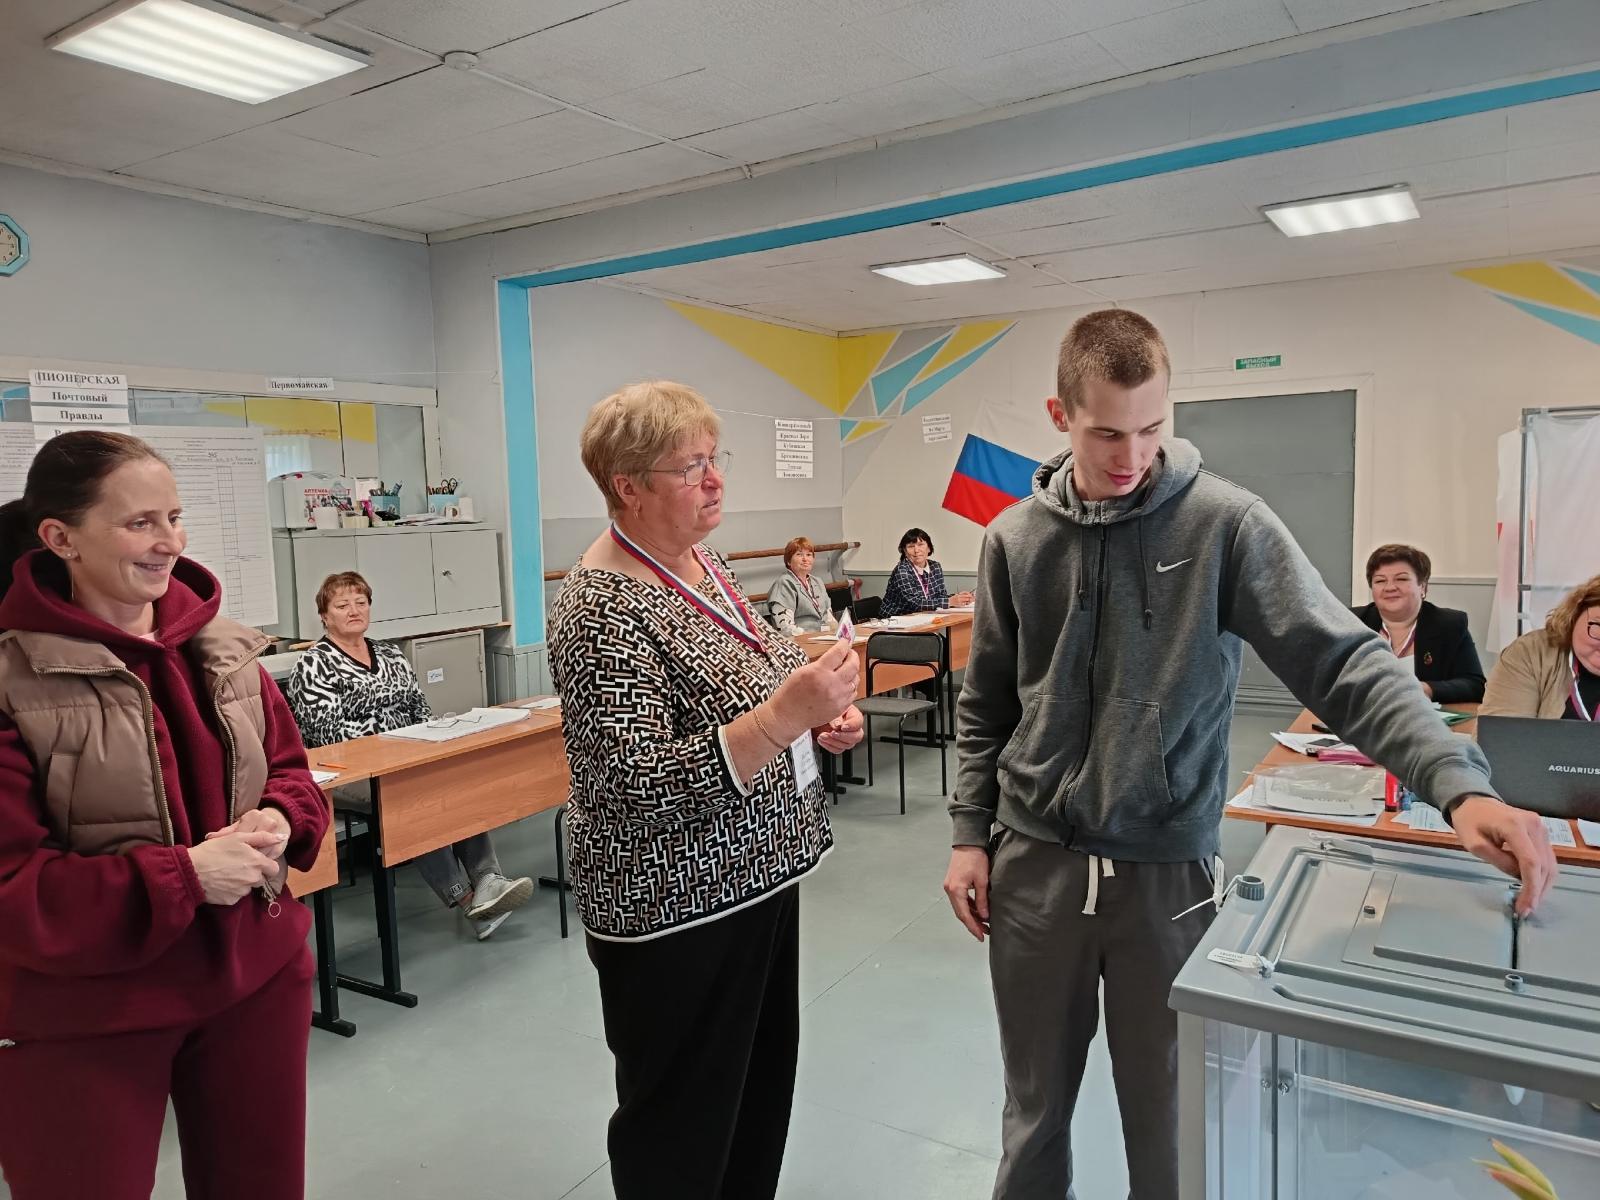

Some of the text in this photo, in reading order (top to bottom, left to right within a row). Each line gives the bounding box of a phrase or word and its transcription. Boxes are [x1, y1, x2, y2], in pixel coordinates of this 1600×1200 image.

[37, 372, 120, 385] ПИОНЕРСКАЯ
[271, 380, 328, 391] Первомайская
[52, 391, 108, 403] Почтовый
[60, 410, 103, 421] Правды
[1548, 764, 1600, 775] AQUARIUS
